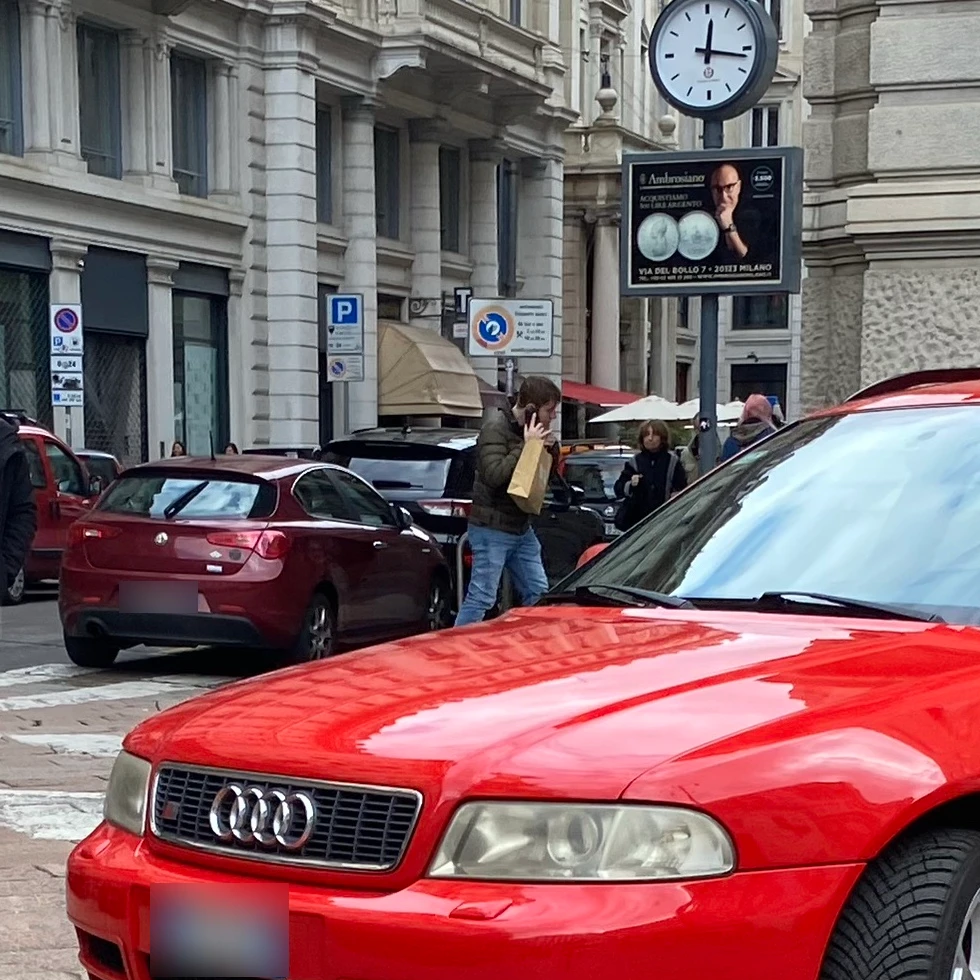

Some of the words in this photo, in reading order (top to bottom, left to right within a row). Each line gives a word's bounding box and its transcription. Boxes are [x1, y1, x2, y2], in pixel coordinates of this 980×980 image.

[649, 171, 705, 184] Ambrosiano
[638, 267, 653, 275] VIA
[654, 266, 670, 275] DEL
[672, 265, 700, 274] BOLLO
[701, 265, 707, 273] 7
[739, 263, 772, 272] MILANO
[456, 289, 471, 313] T
[337, 301, 353, 322] P
